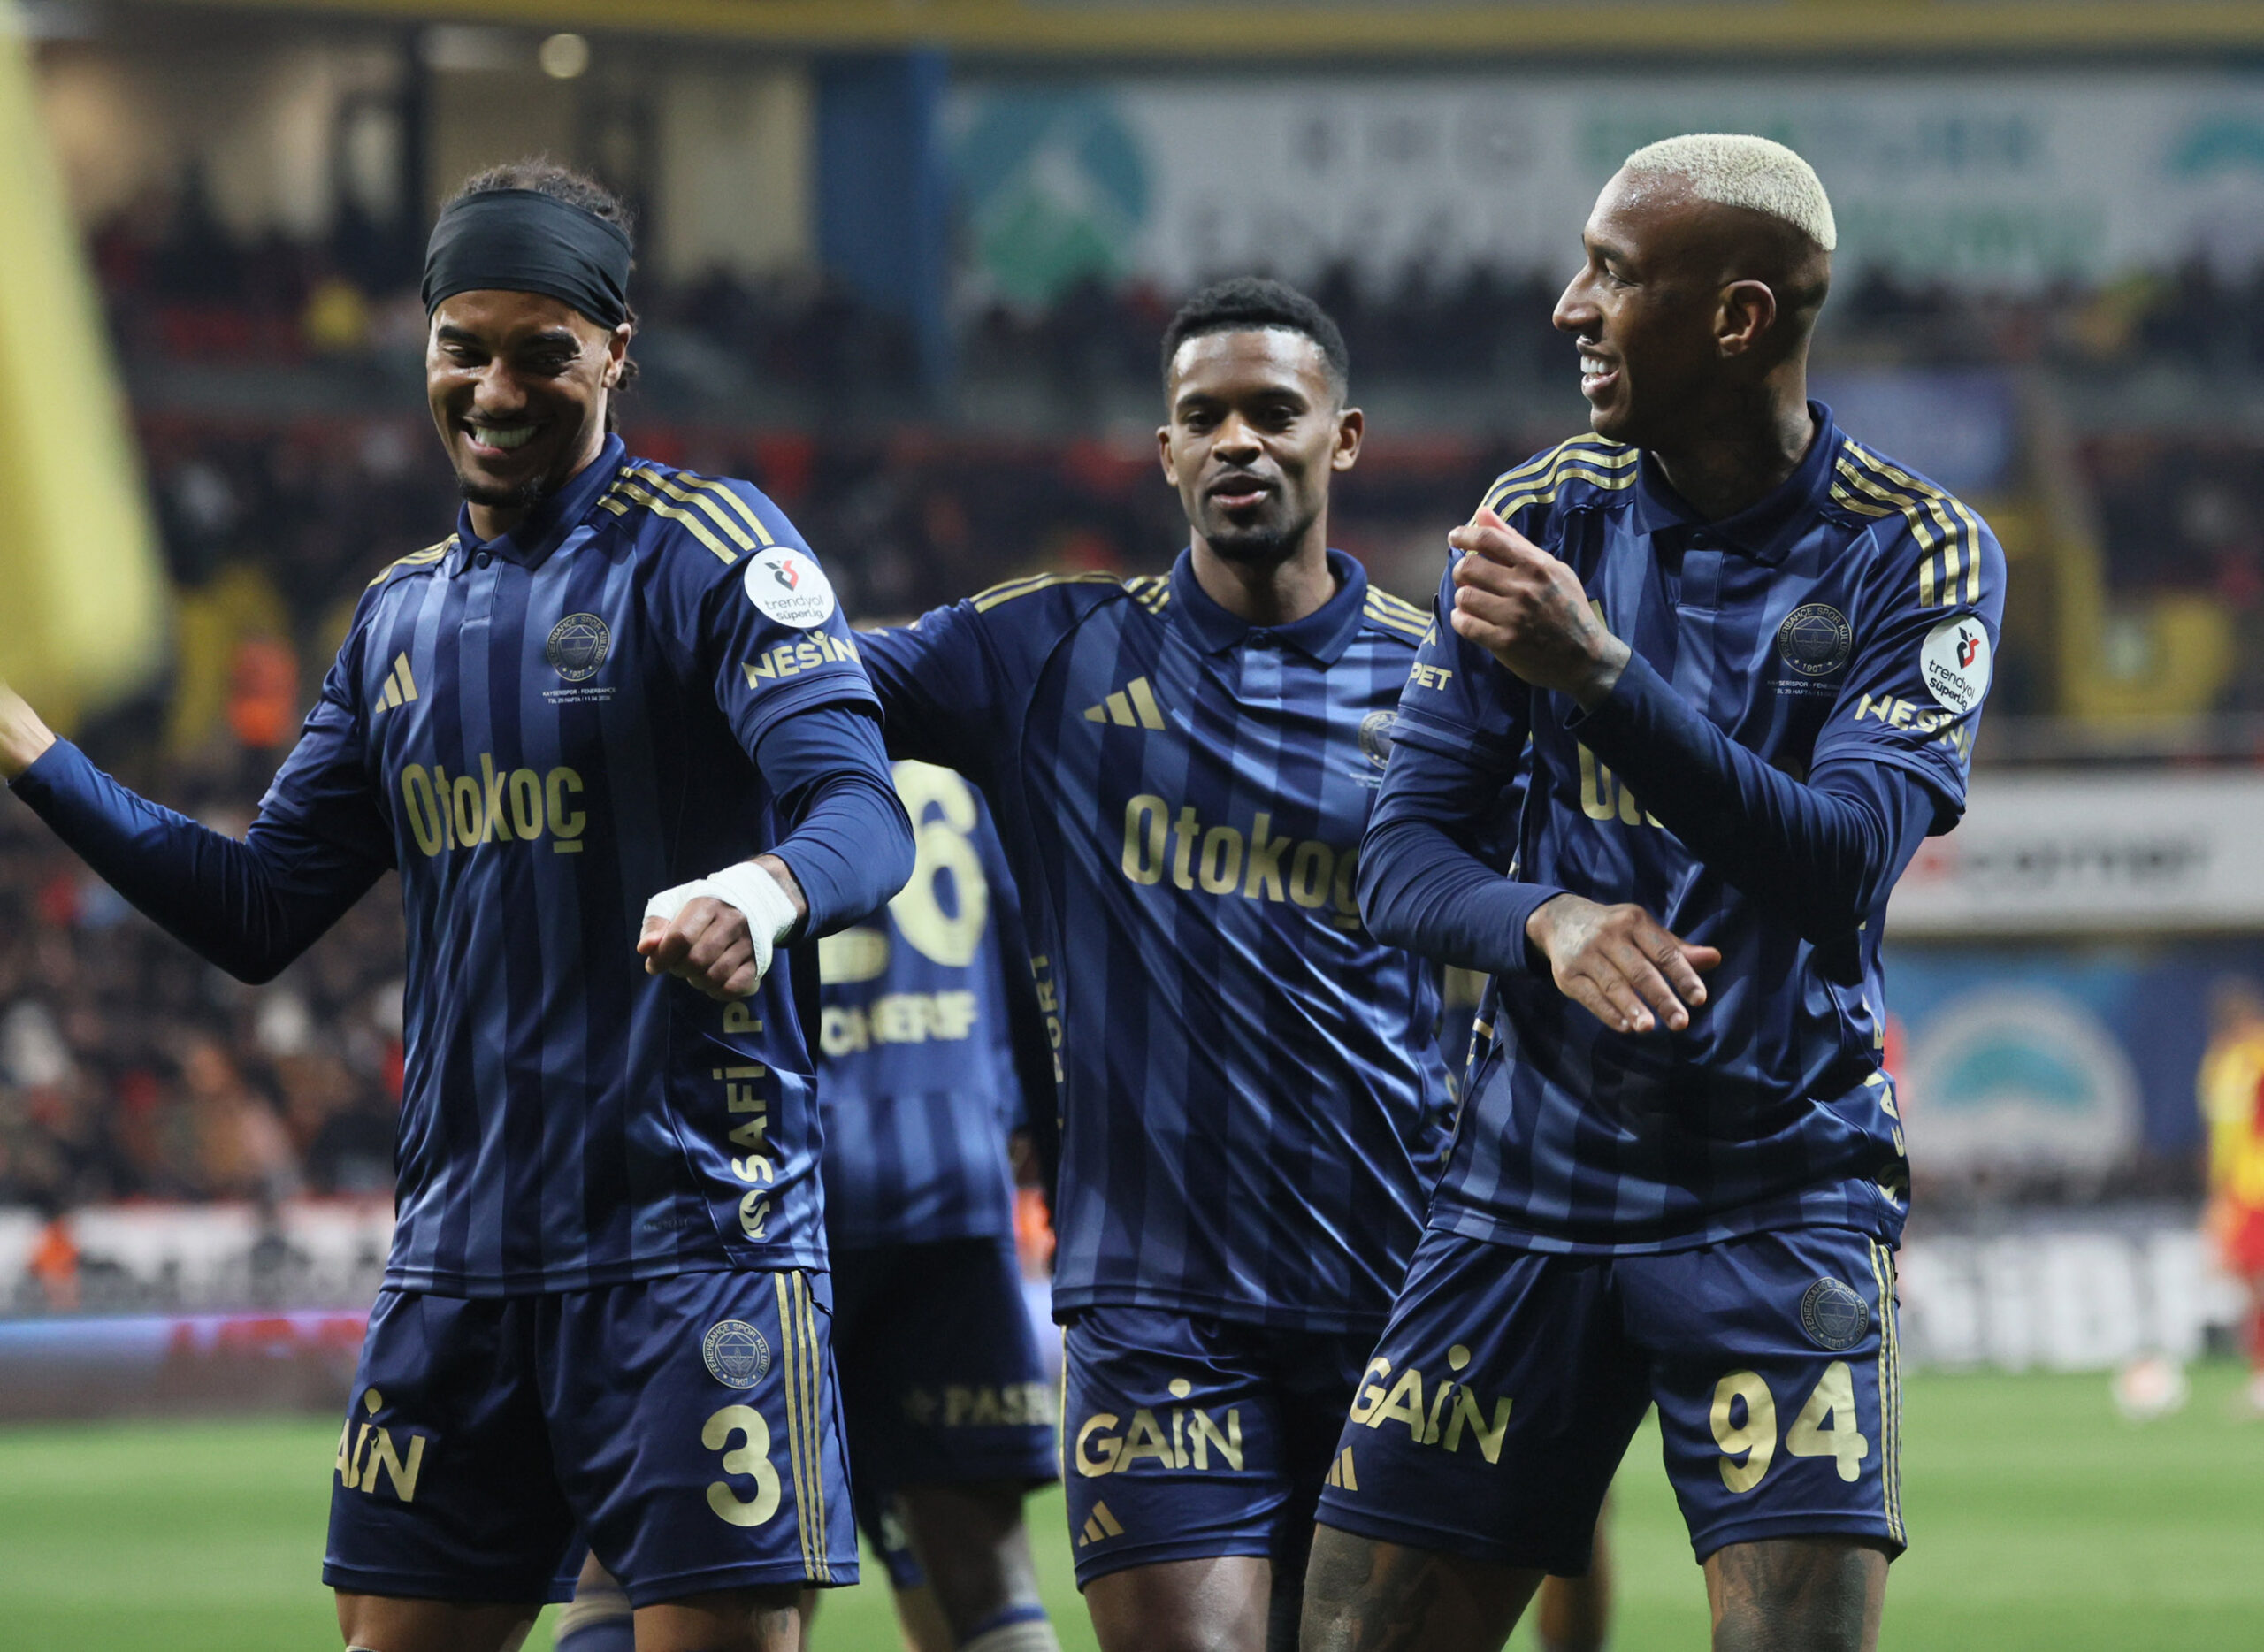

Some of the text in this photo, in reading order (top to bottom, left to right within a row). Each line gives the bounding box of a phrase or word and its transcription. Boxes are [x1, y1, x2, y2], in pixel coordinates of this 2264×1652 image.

[765, 595, 823, 609] trendyol
[1803, 663, 1823, 673] 1907
[1929, 659, 1975, 700] trendyol
[401, 753, 585, 858] Otokoç
[733, 1323, 757, 1338] SPOR
[731, 1377, 748, 1386] 1907
[1709, 1359, 1869, 1494] 94
[701, 1404, 781, 1527] 3
